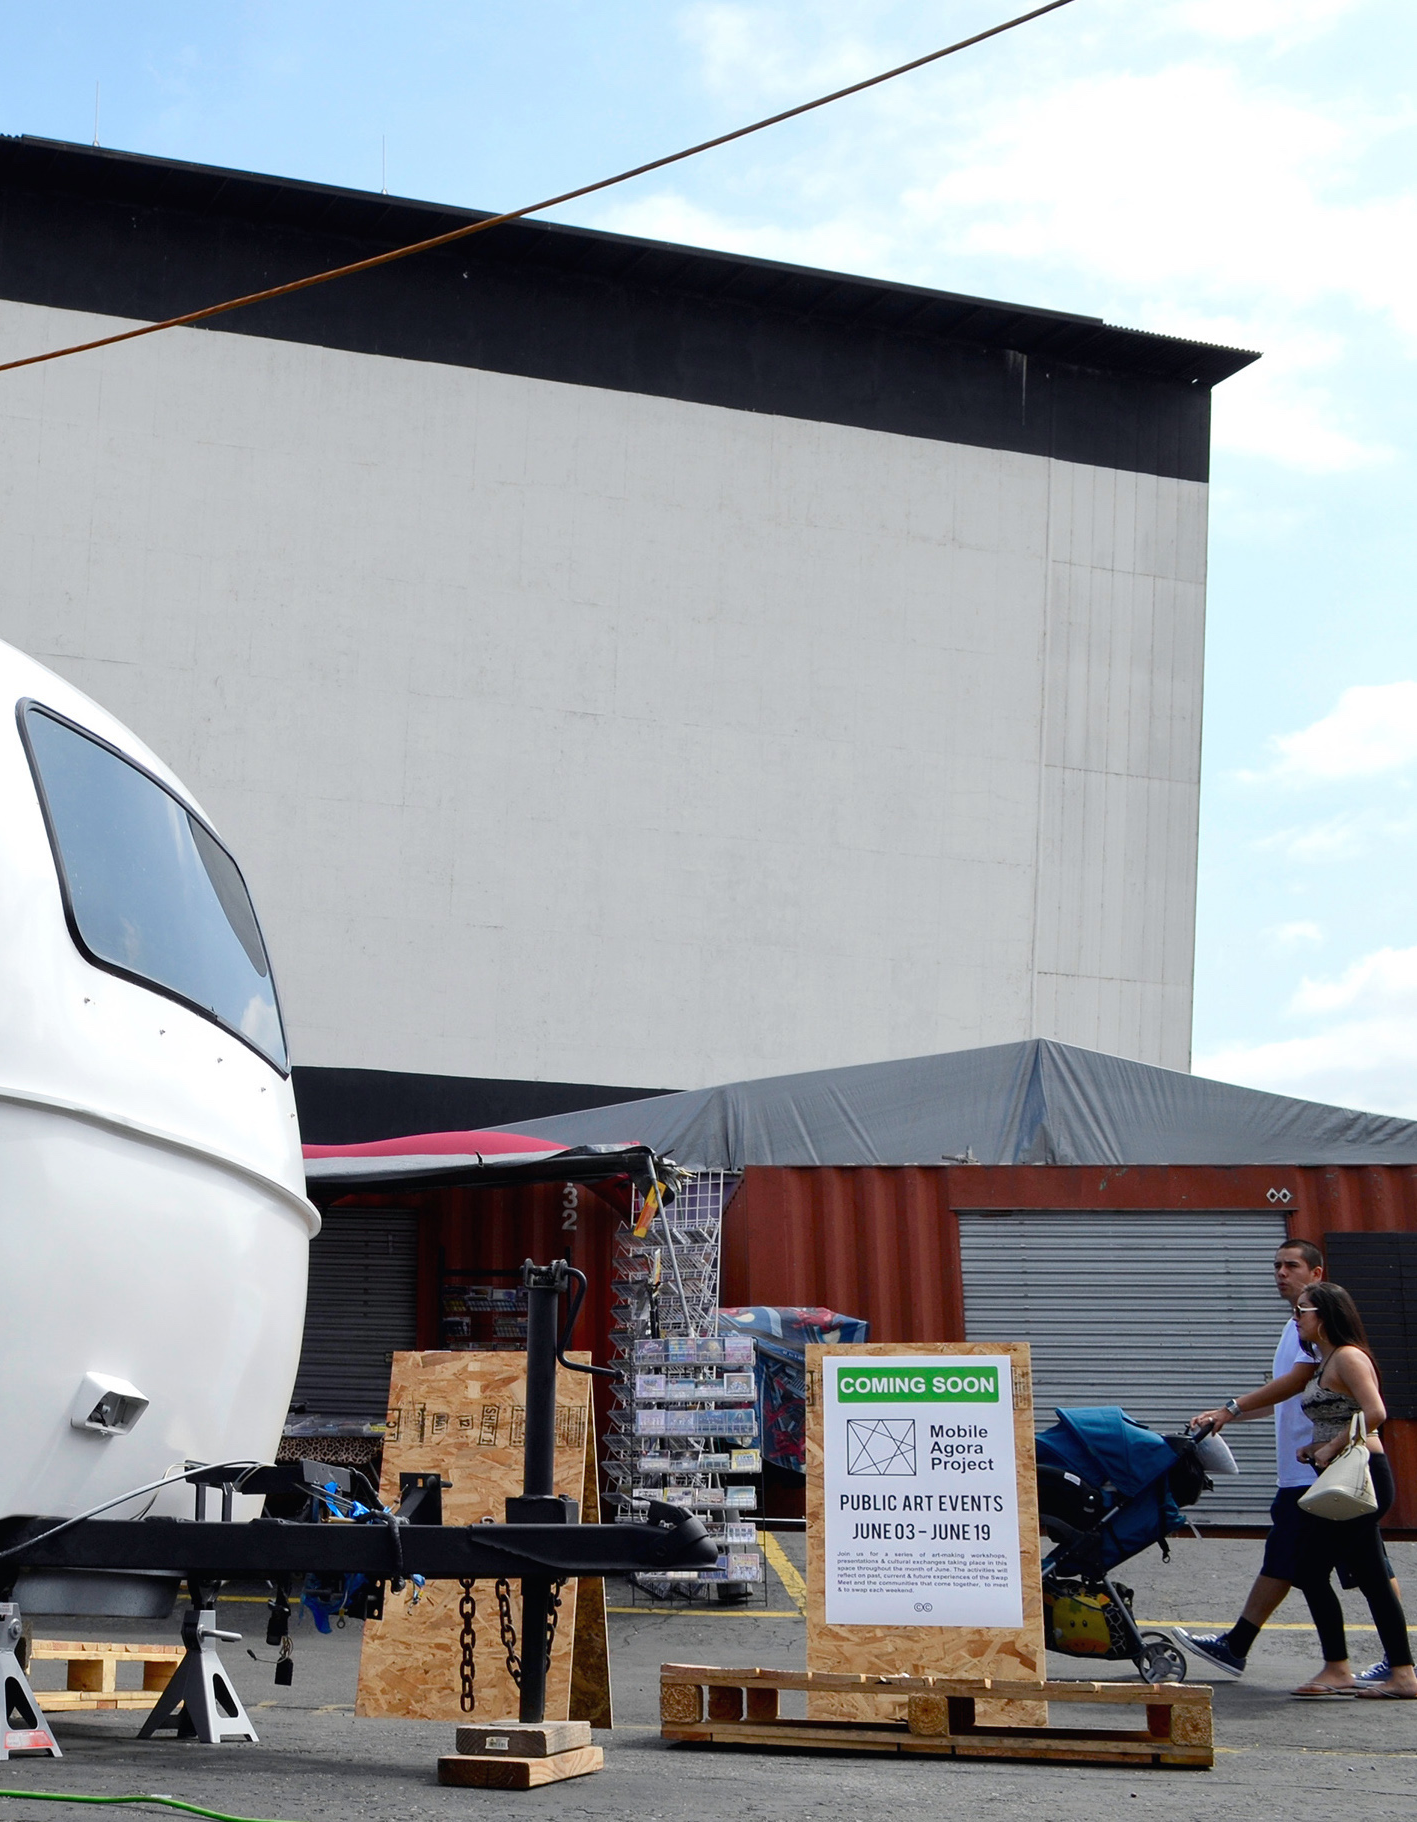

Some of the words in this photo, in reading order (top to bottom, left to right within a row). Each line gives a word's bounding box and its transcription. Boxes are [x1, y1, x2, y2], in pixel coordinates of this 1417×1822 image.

[562, 1182, 578, 1230] 32
[840, 1377, 926, 1394] COMING
[932, 1377, 995, 1393] SOON
[930, 1425, 988, 1438] Mobile
[930, 1441, 983, 1458] Agora
[931, 1457, 994, 1474] Project
[840, 1495, 897, 1511] PUBLIC
[902, 1495, 934, 1512] ART
[939, 1495, 1003, 1512] EVENTS
[852, 1523, 892, 1540] JUNE
[895, 1523, 915, 1540] 03
[930, 1524, 970, 1541] JUNE
[974, 1524, 991, 1541] 19
